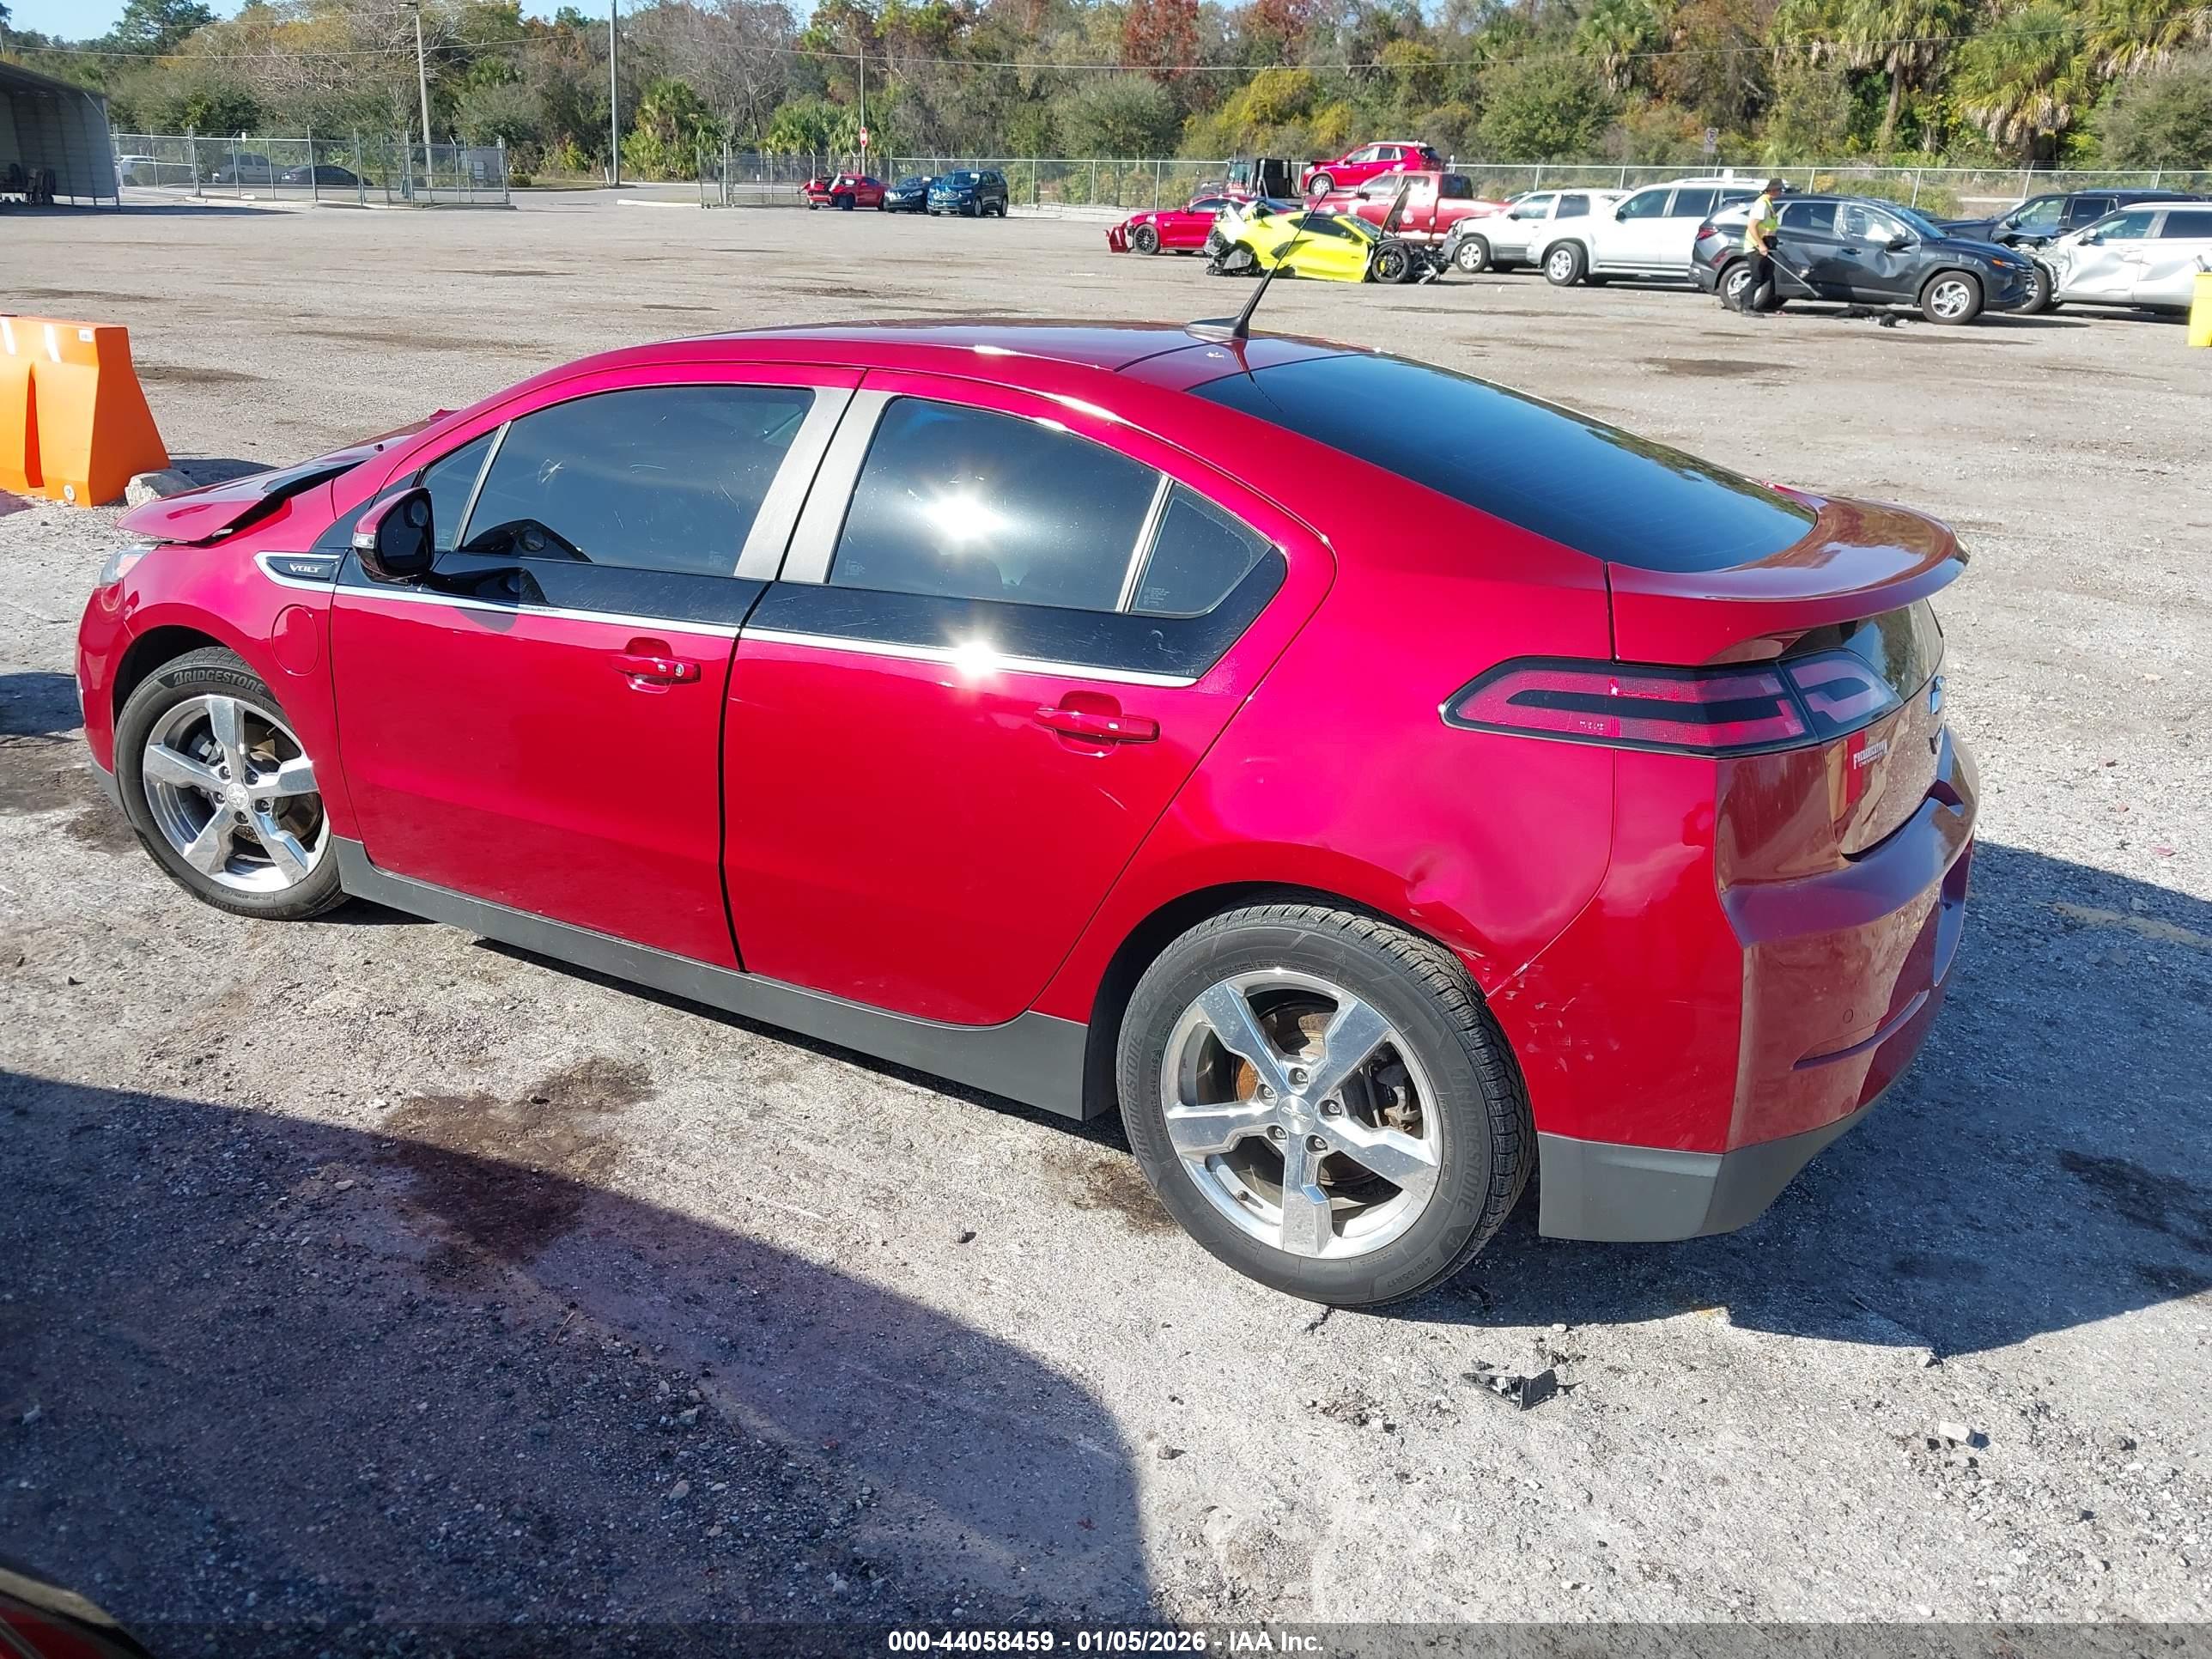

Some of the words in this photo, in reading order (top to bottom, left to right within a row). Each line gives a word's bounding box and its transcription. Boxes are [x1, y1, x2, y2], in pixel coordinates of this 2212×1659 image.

[289, 562, 322, 574] VOLT
[173, 669, 266, 695] BRIDGESTONE
[1125, 1034, 1152, 1162] BRIDGESTONE
[1449, 1066, 1484, 1213] BRIDGESTONE
